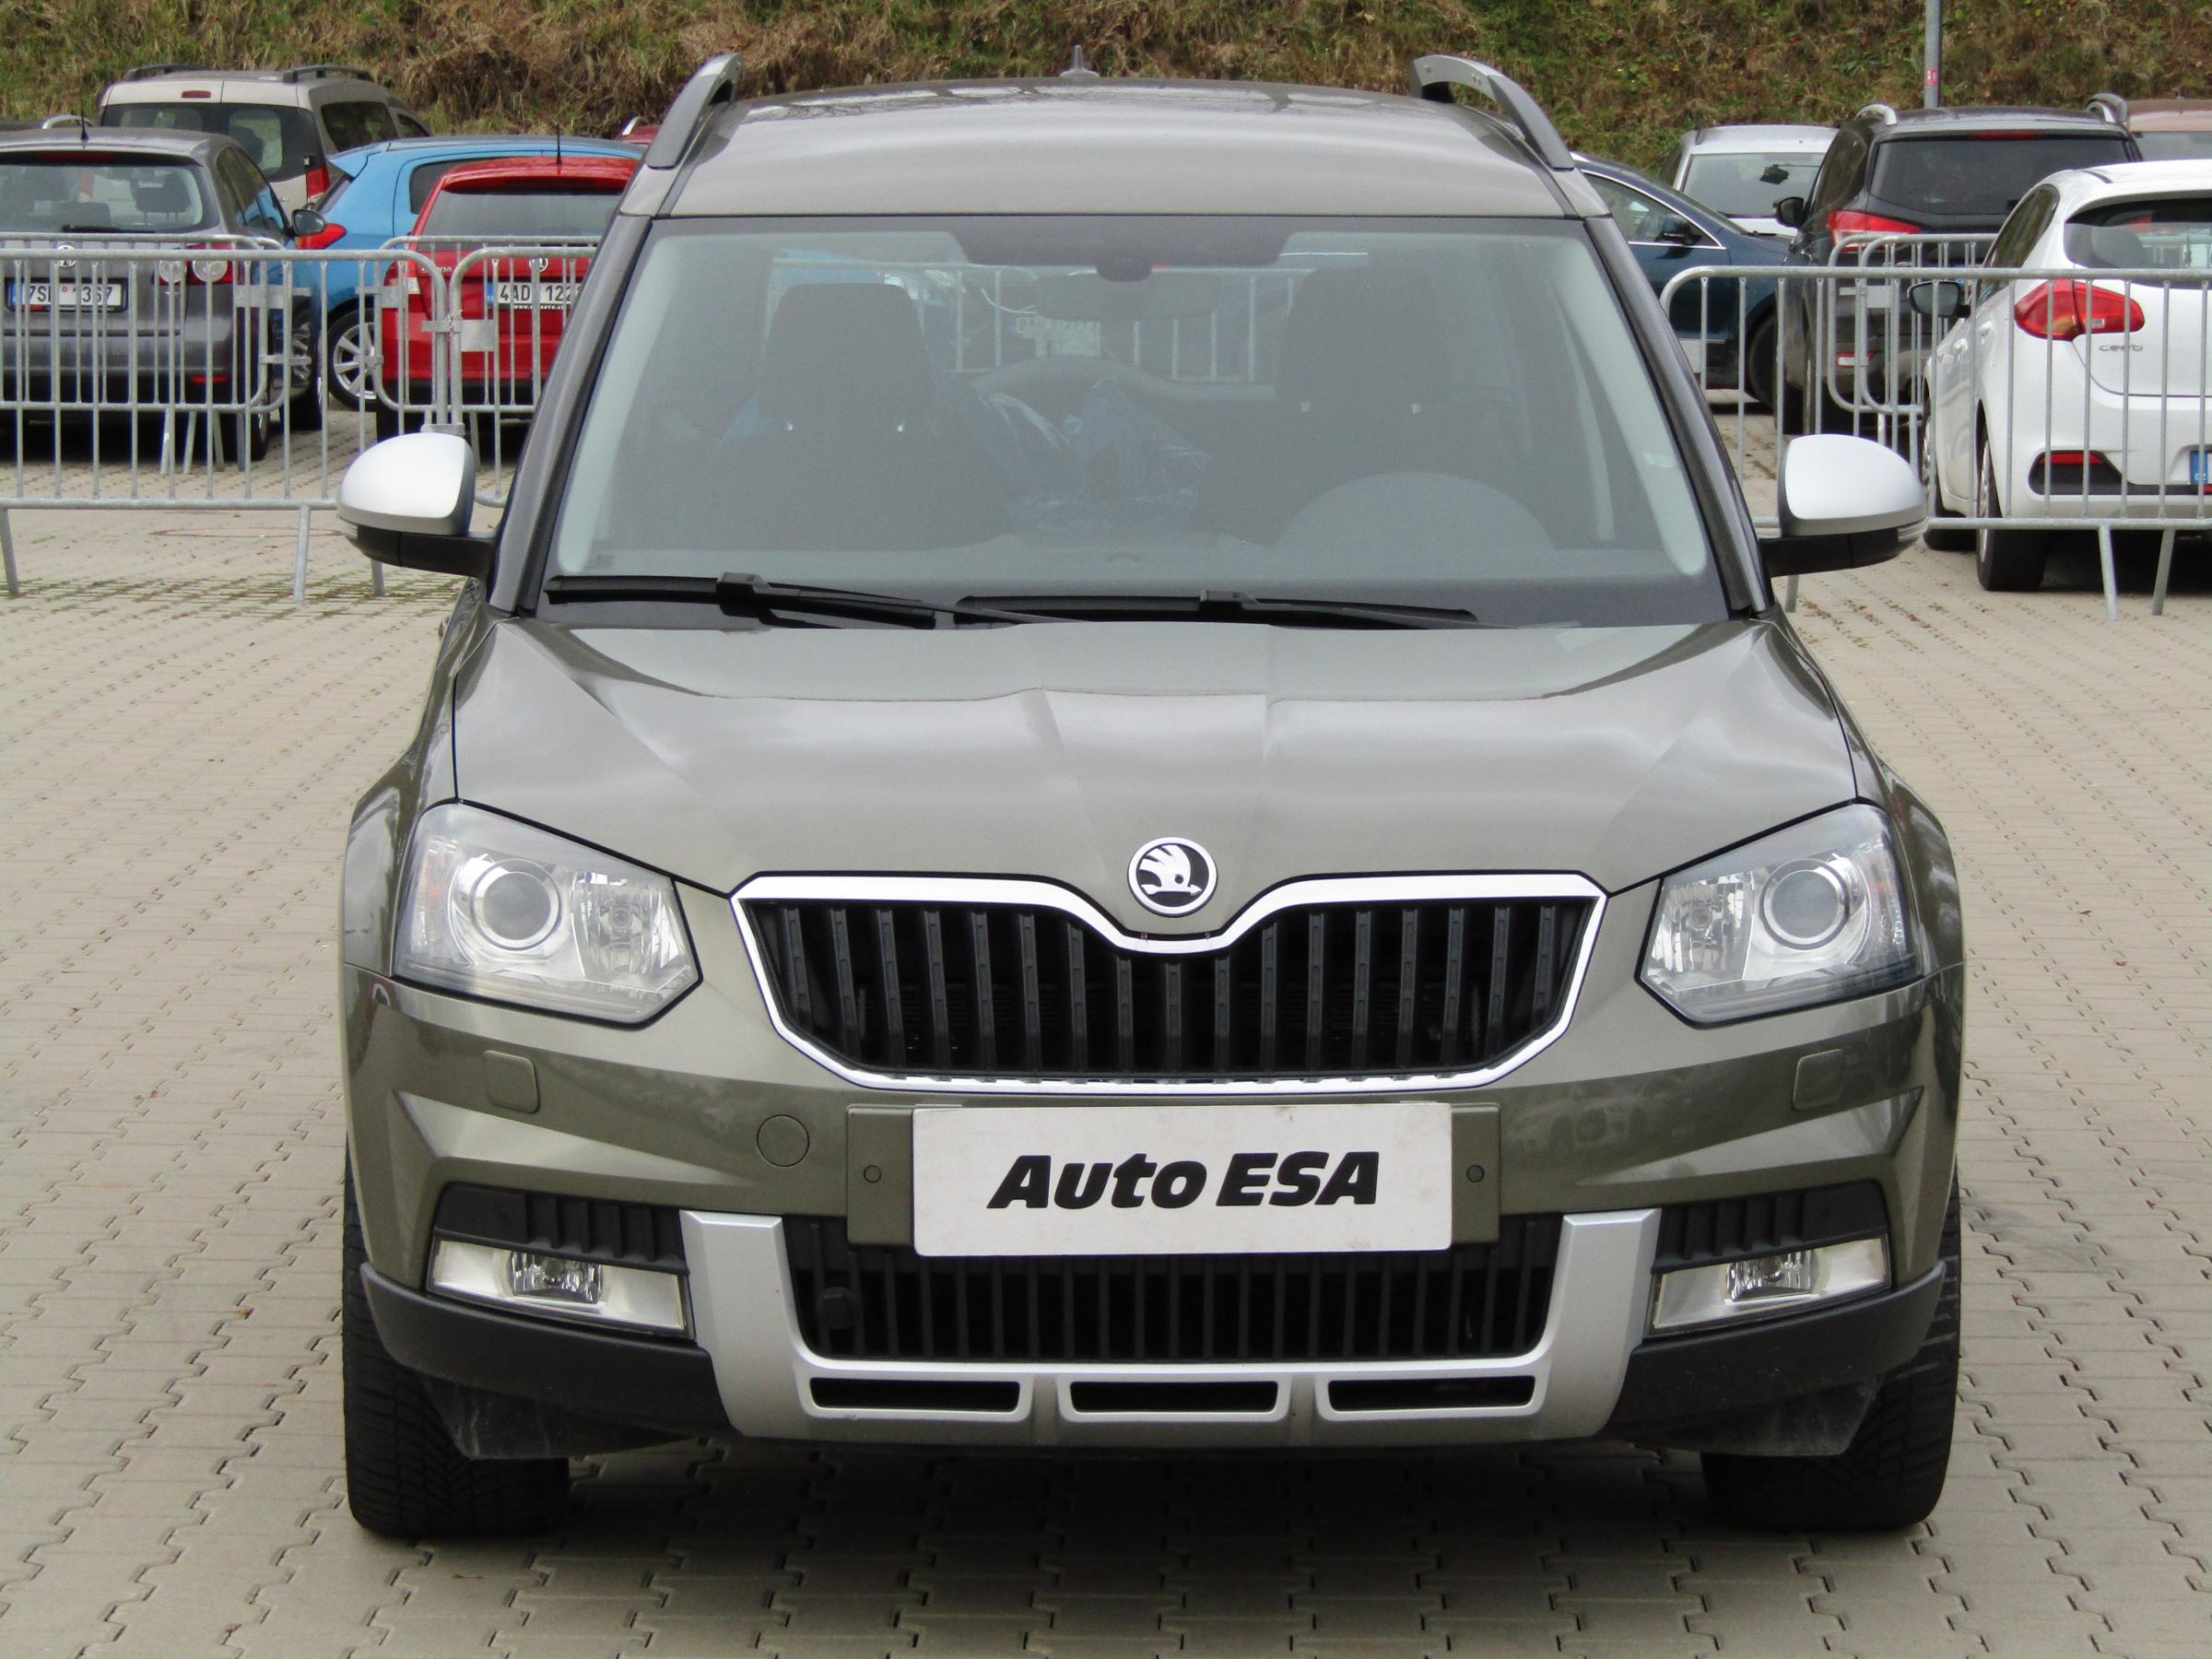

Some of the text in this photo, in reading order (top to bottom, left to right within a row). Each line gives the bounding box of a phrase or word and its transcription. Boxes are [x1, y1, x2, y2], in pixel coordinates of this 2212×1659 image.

[28, 285, 56, 302] 7S
[987, 1151, 1379, 1209] Auto ESA
